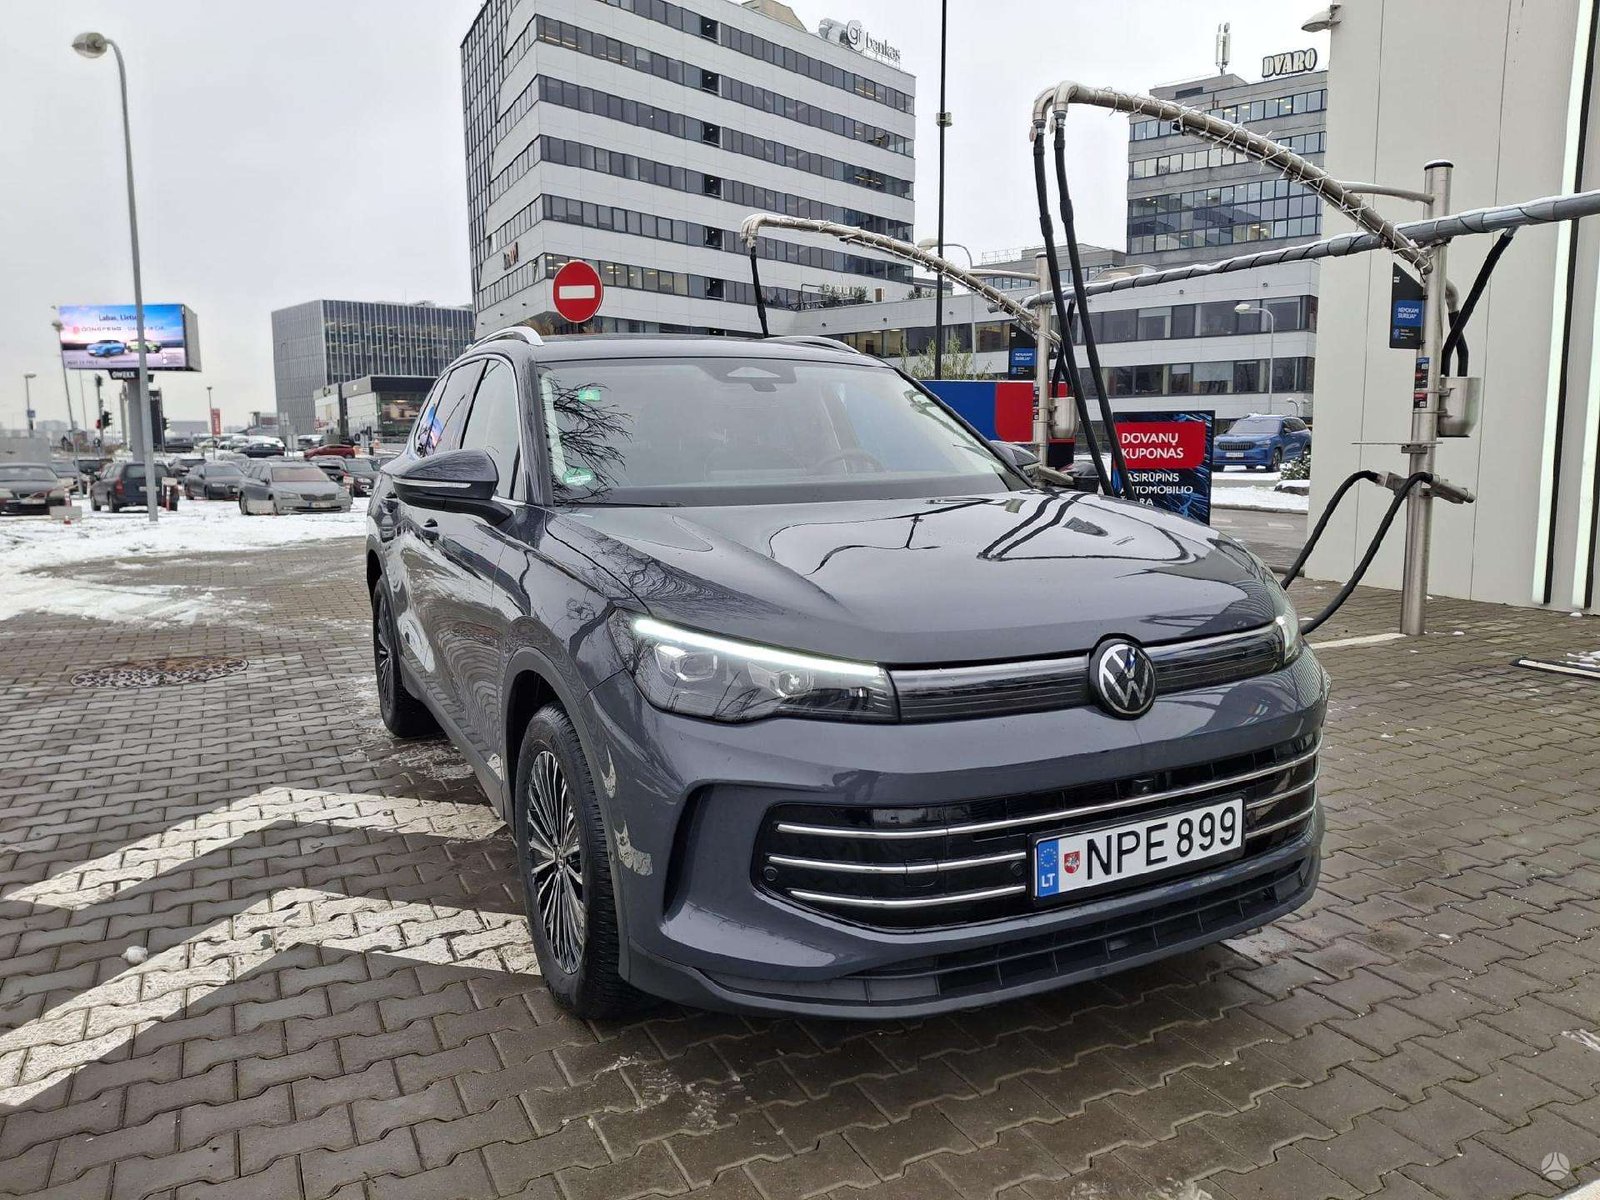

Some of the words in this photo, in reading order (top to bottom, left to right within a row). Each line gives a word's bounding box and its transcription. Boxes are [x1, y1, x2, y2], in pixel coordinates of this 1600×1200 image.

[865, 31, 901, 61] bankas
[1262, 48, 1318, 78] DVARO
[1121, 432, 1179, 446] DOVANŲ
[1120, 447, 1184, 459] KUPONAS
[1127, 471, 1180, 482] ASIRŪPINS
[1086, 822, 1168, 880] NPE
[1176, 806, 1236, 858] 899
[1040, 872, 1057, 888] LT
